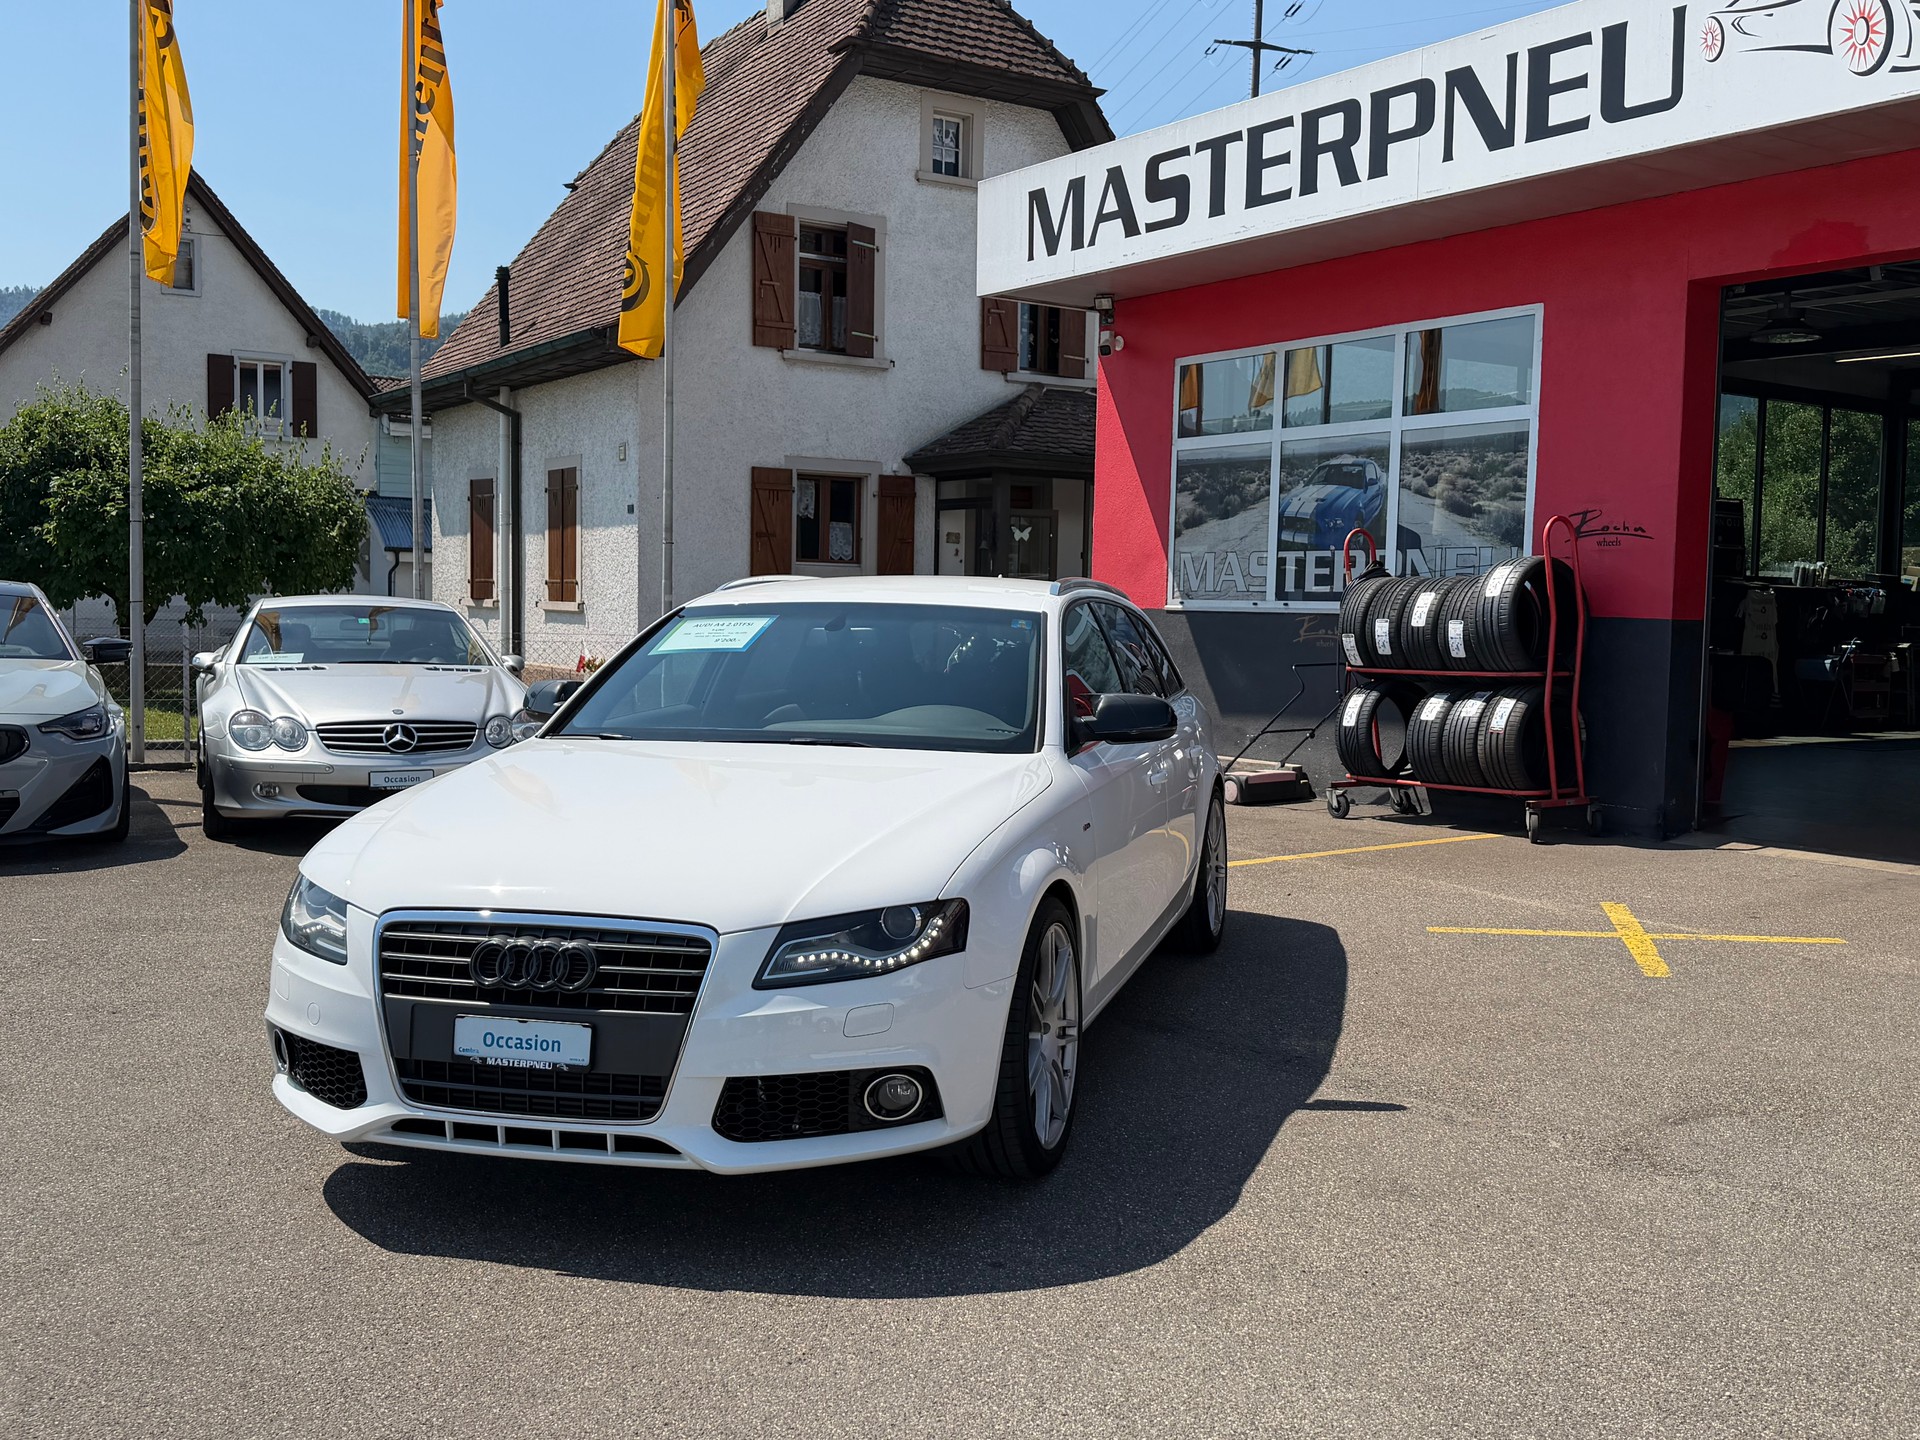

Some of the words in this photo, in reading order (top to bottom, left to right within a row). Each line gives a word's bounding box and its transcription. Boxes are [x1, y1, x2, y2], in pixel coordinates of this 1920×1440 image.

[1028, 5, 1686, 261] MASTERPNEU
[1566, 509, 1654, 541] Rocha
[1596, 537, 1621, 547] wheels
[1293, 614, 1340, 642] Roch
[384, 775, 421, 784] Occasion
[482, 1031, 561, 1053] Occasion
[486, 1057, 553, 1070] MASTERPNEU
